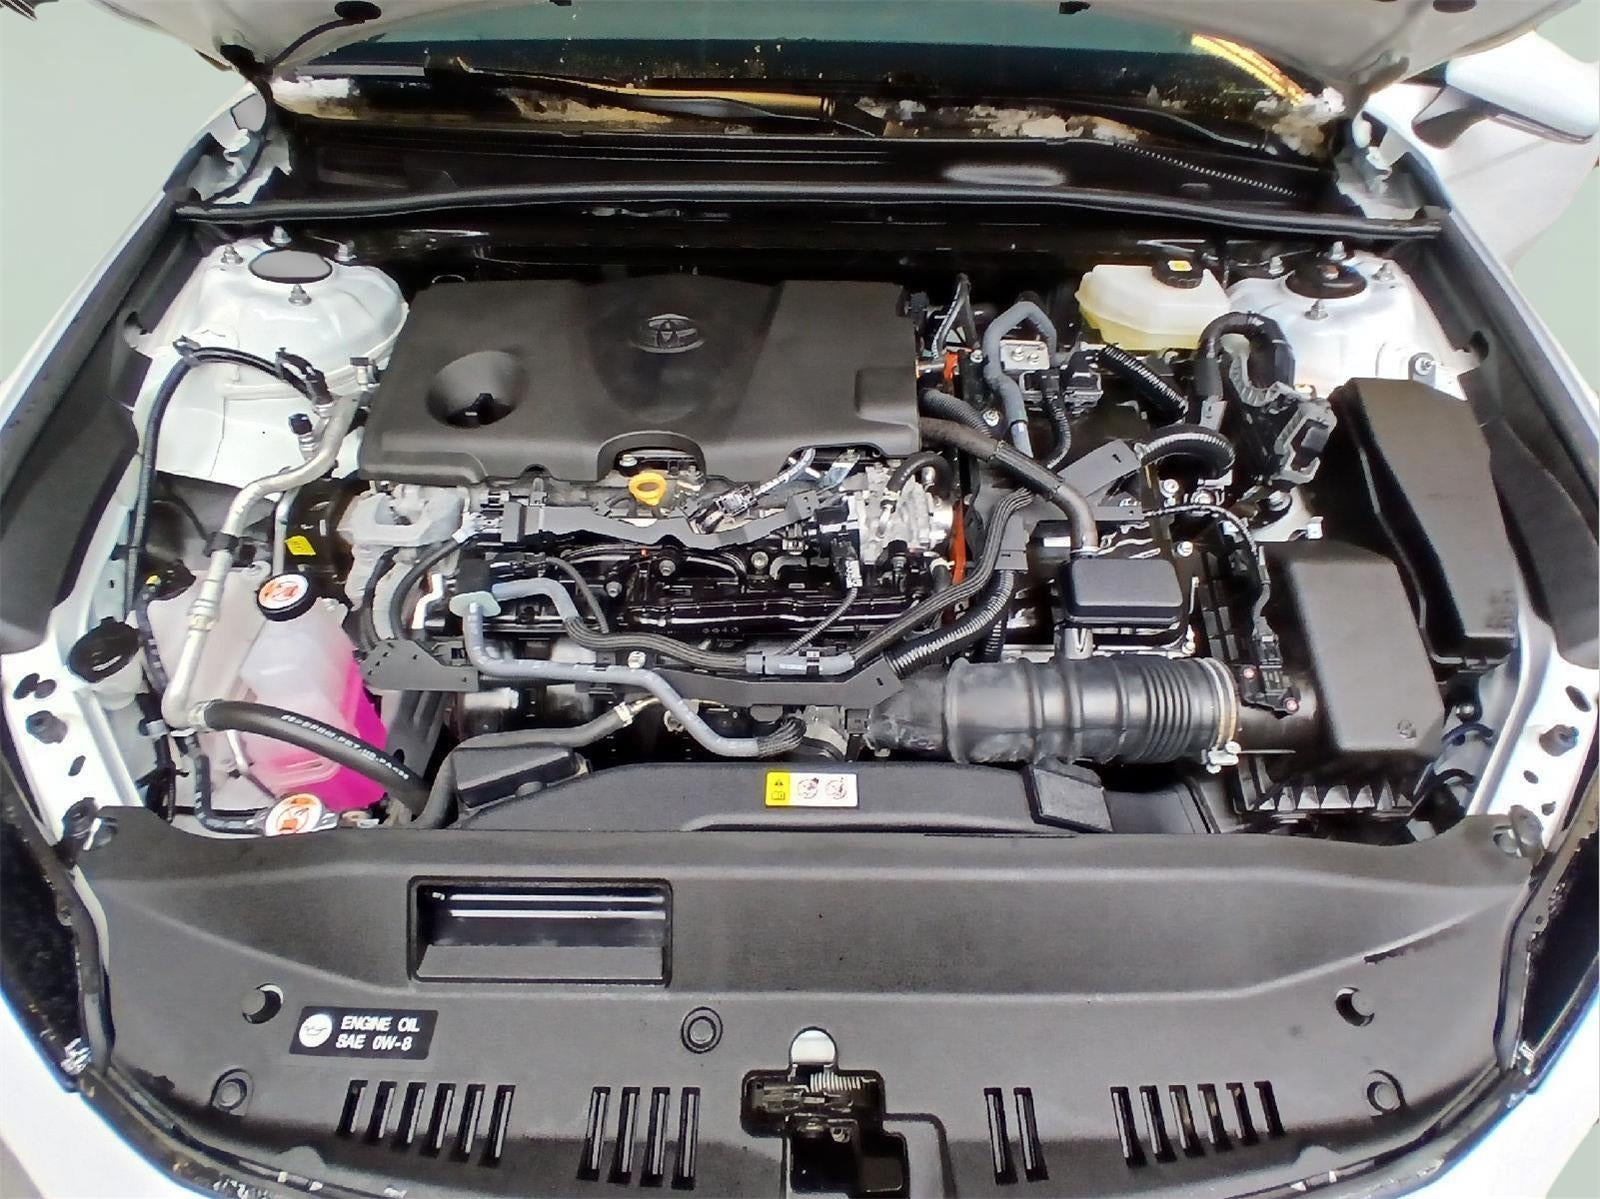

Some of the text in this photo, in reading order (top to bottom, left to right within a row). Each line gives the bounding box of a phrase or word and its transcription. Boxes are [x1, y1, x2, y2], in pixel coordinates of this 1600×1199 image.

[341, 1015, 420, 1032] ENGINE OIL
[336, 1034, 412, 1051] SAE 0W-8
